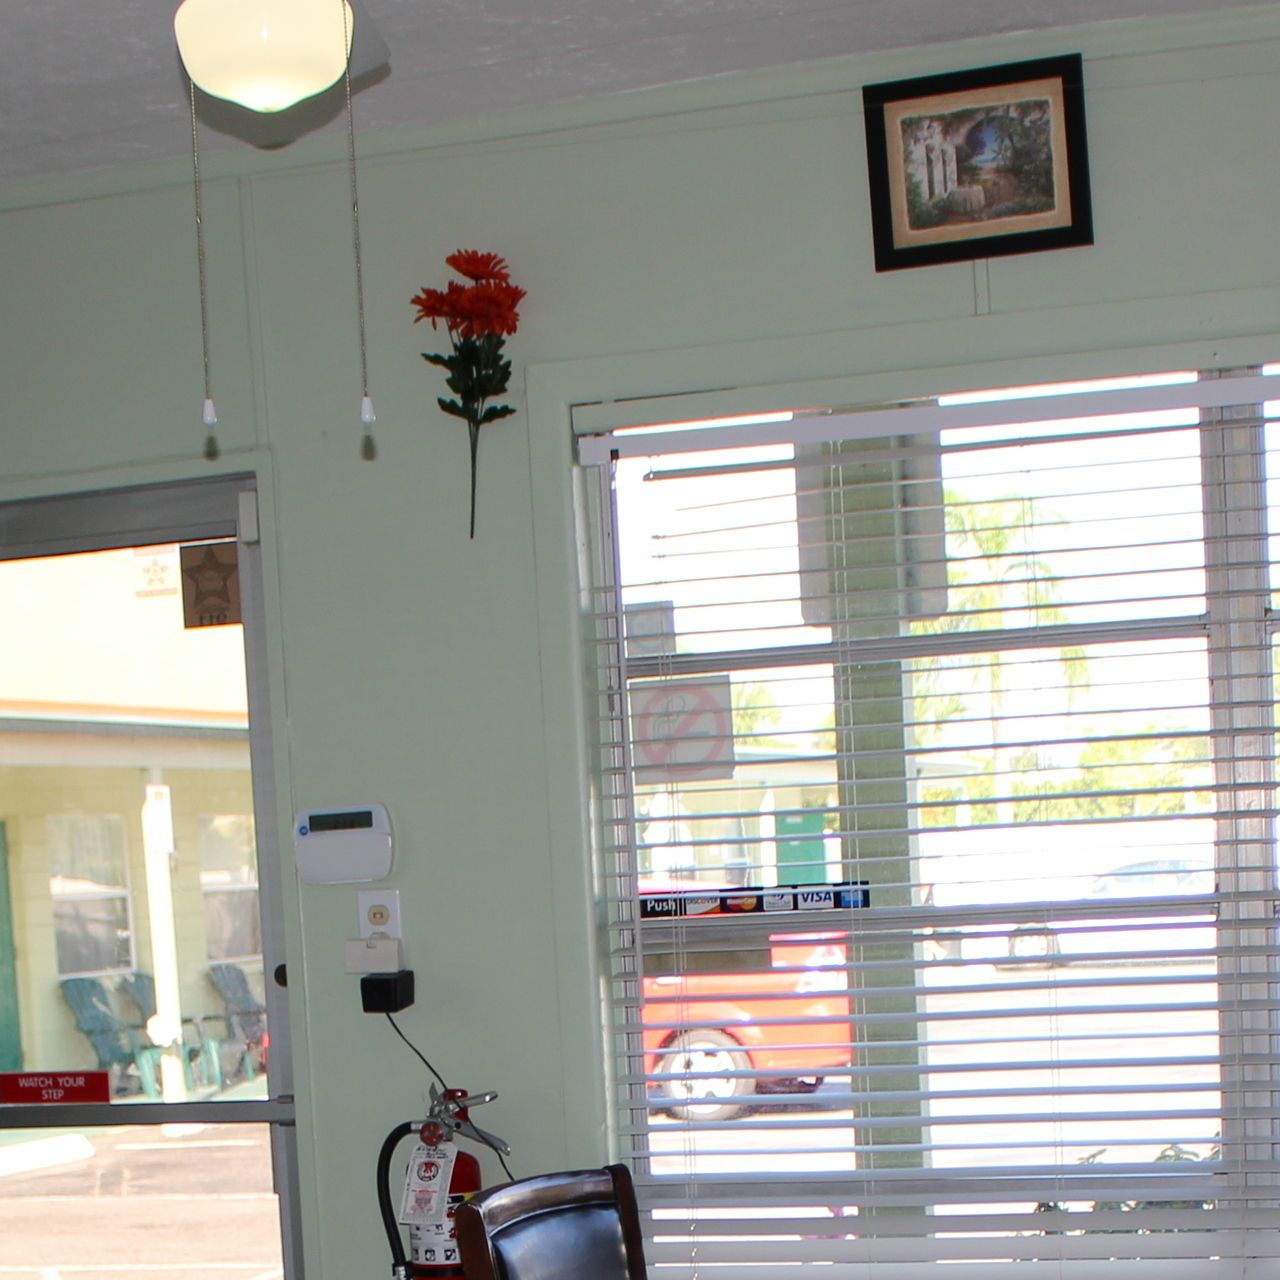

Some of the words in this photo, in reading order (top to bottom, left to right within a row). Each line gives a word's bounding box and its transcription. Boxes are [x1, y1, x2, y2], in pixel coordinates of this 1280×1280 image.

[802, 890, 833, 903] VISA
[646, 898, 677, 912] Push
[18, 1076, 53, 1087] WATCH
[58, 1076, 85, 1087] YOUR
[41, 1089, 64, 1100] STEP
